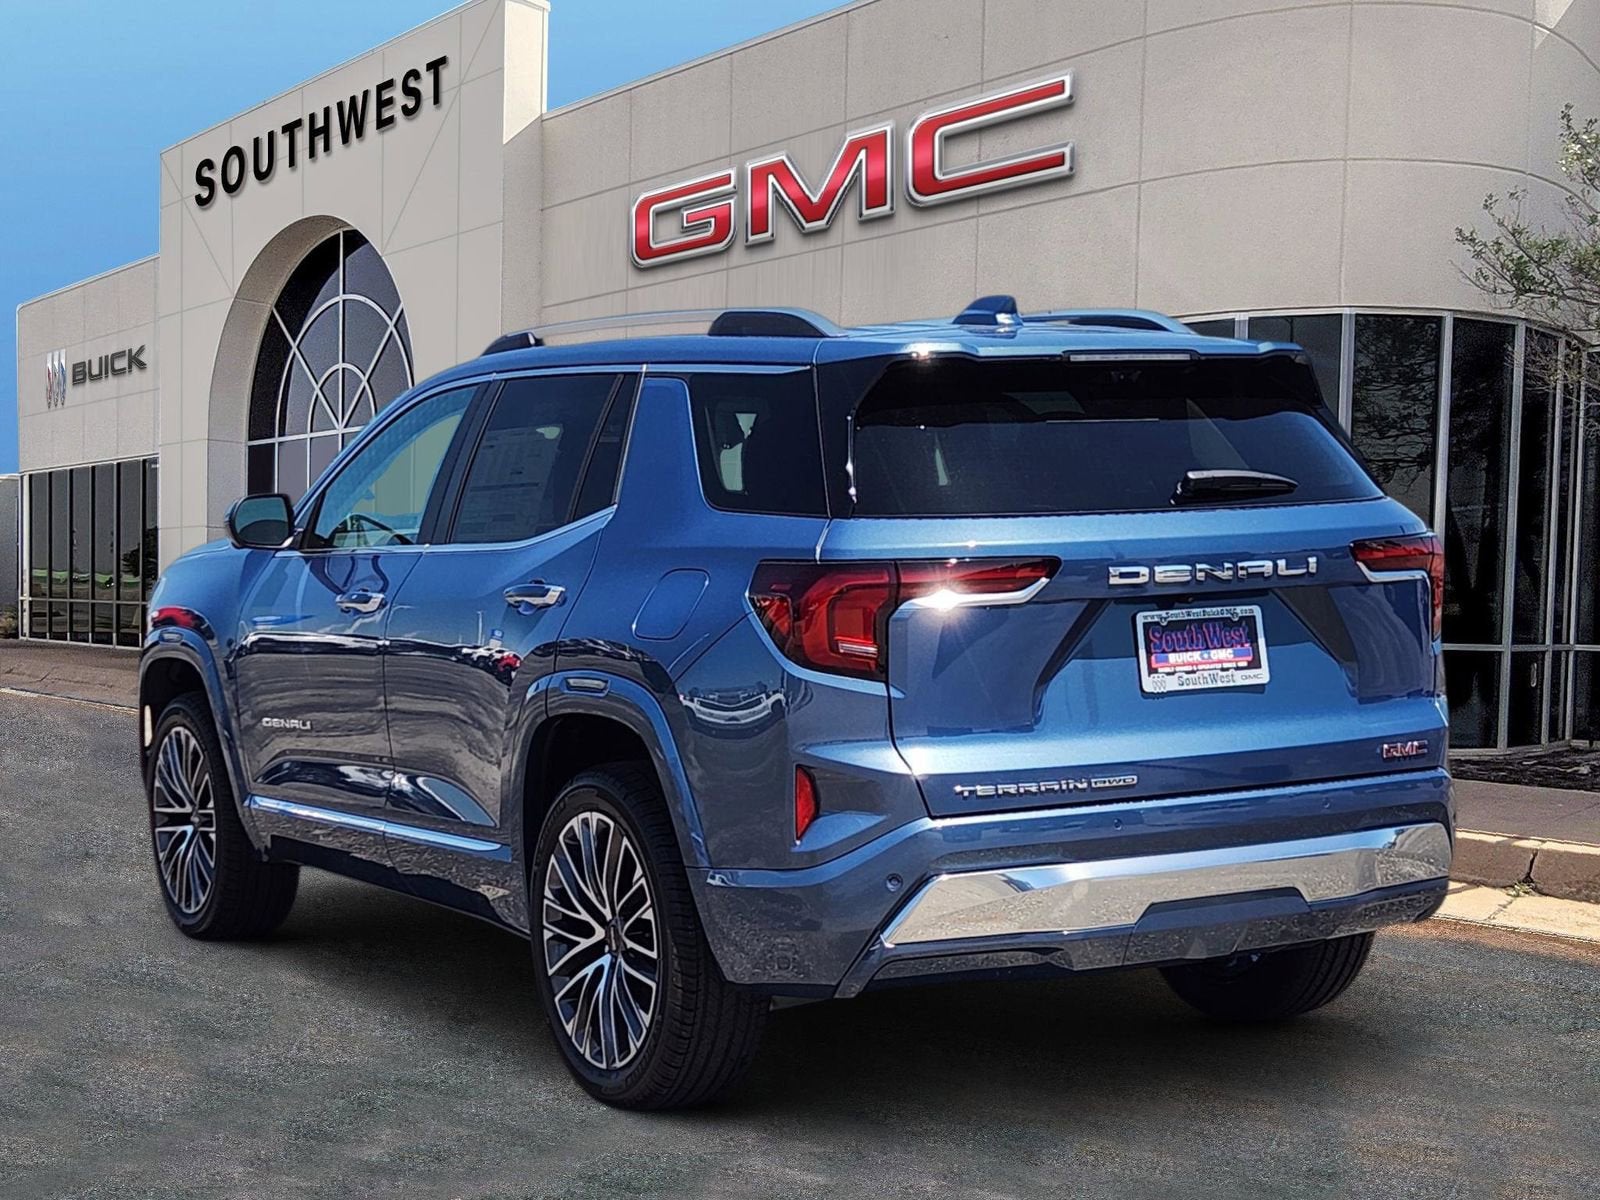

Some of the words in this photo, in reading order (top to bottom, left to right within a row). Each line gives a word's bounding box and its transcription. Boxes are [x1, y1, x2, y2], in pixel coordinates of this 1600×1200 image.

[194, 55, 448, 207] SOUTHWEST
[630, 68, 1075, 269] GMC
[72, 344, 147, 385] BUICK
[1108, 556, 1318, 585] DENALI
[1149, 621, 1250, 653] SouthWest
[1168, 652, 1201, 664] BUICK
[1210, 648, 1234, 660] GMC
[1178, 672, 1236, 686] SouthWest
[262, 717, 312, 730] DENALI
[1382, 740, 1429, 759] GMC
[953, 778, 1088, 796] TERRAIN
